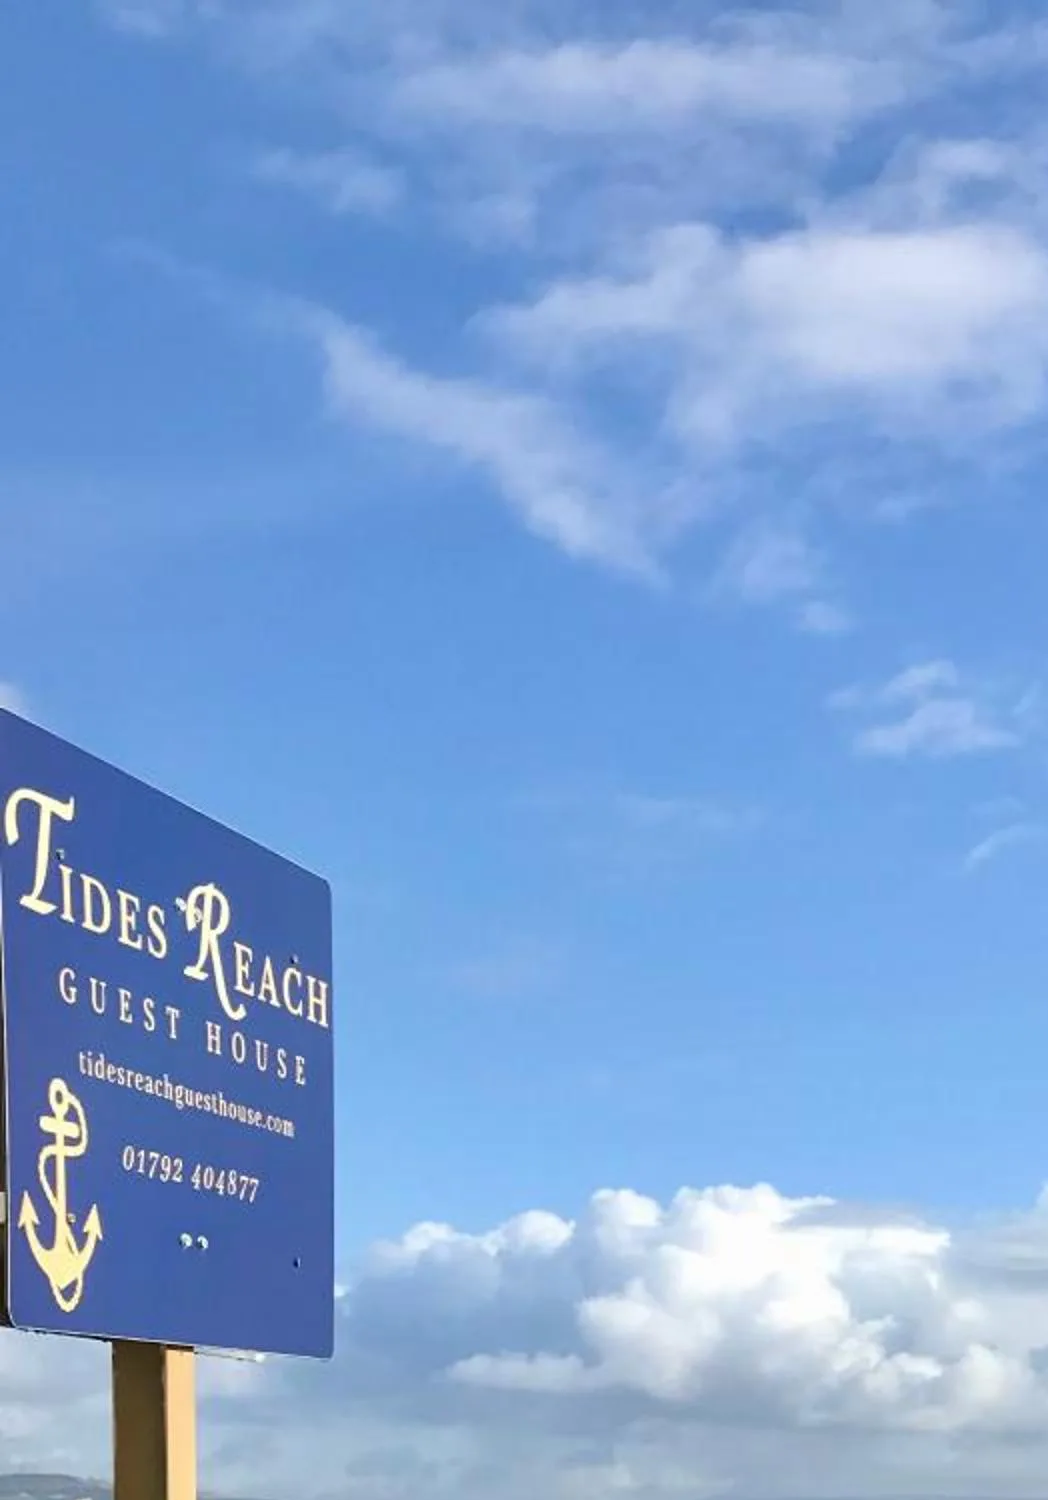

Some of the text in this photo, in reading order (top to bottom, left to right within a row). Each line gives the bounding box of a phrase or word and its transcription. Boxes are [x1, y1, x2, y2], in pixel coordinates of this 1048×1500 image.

[4, 787, 330, 1029] TIDES REACH
[59, 966, 306, 1087] GUEST HOUSE
[78, 1050, 296, 1139] tidesreachguesthouse.com
[122, 1145, 260, 1204] 01792 404877
